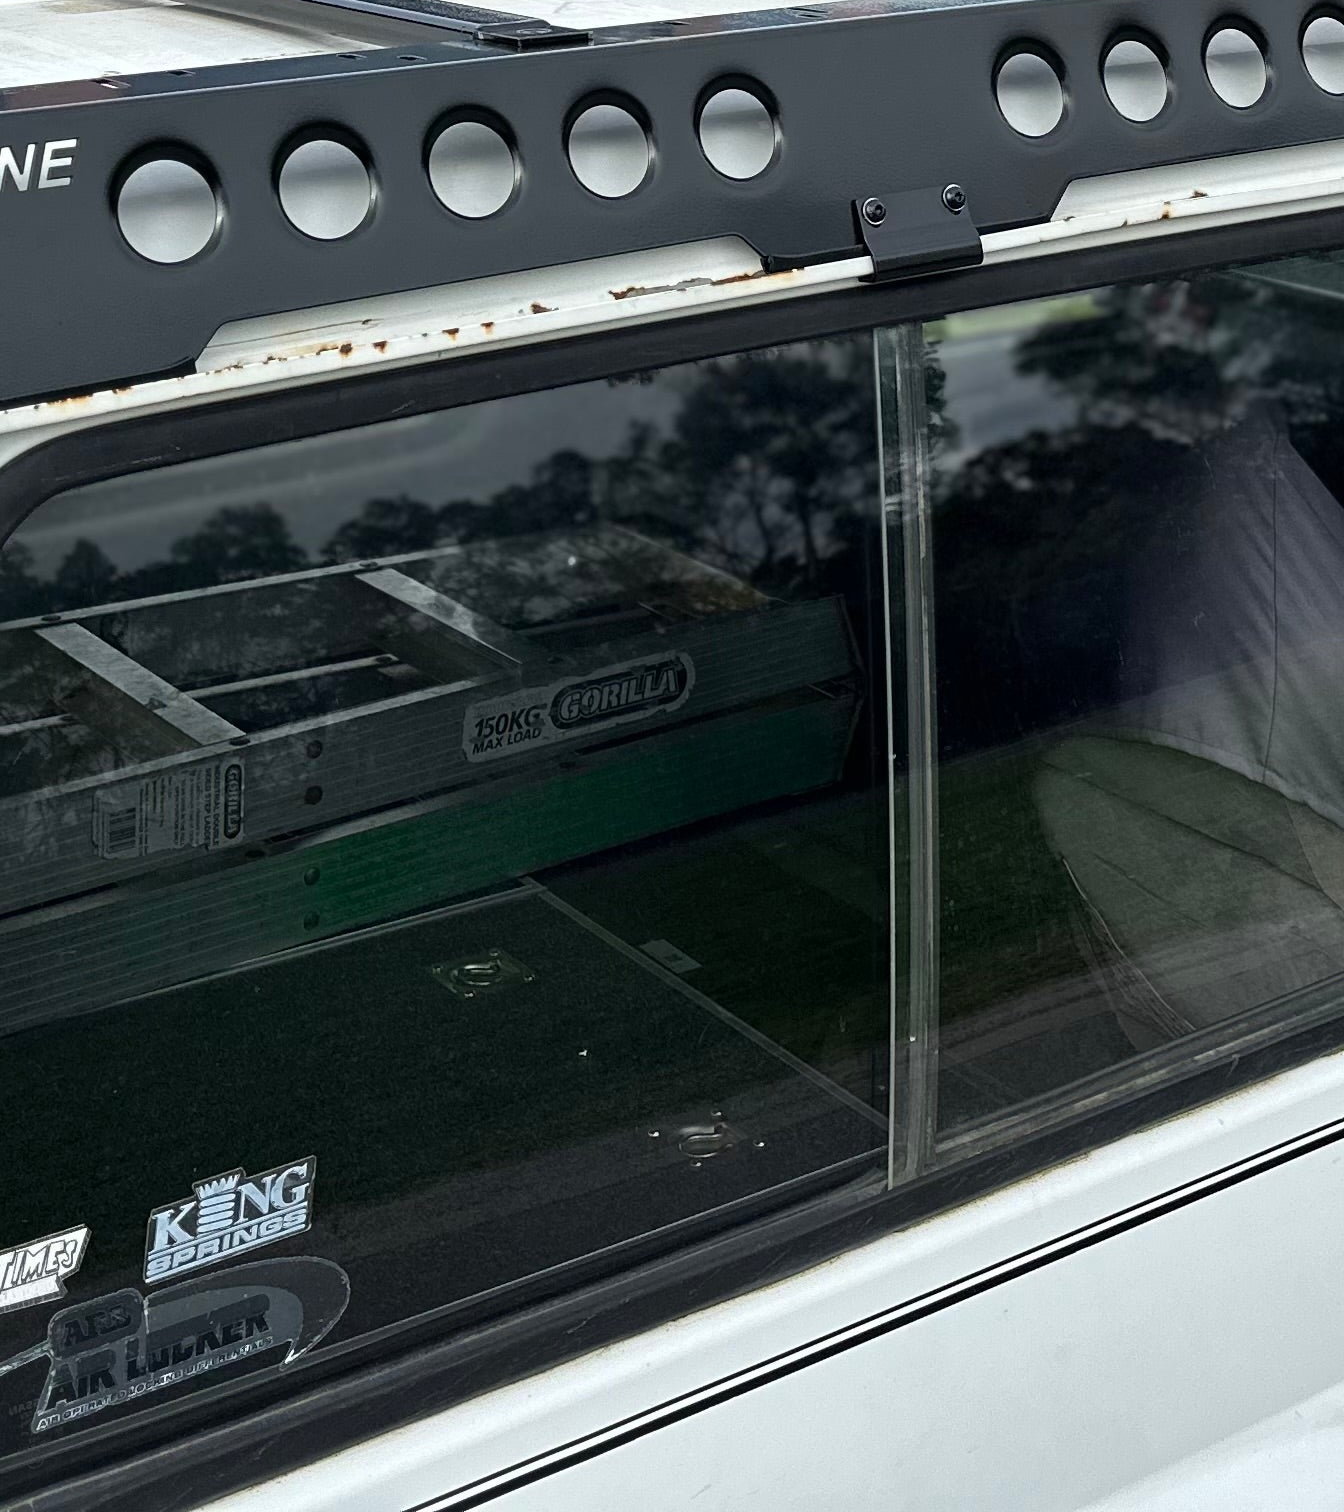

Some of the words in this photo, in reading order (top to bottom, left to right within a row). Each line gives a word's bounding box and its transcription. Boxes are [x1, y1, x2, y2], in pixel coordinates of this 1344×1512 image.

[474, 703, 548, 738] 150KG
[559, 668, 679, 721] GORILLA
[472, 736, 503, 755] MAX
[506, 727, 541, 745] LOAD
[227, 767, 240, 834] GORILLA
[152, 1162, 310, 1252] KING
[147, 1208, 307, 1278] SPRINGS
[35, 1414, 61, 1431] AIR
